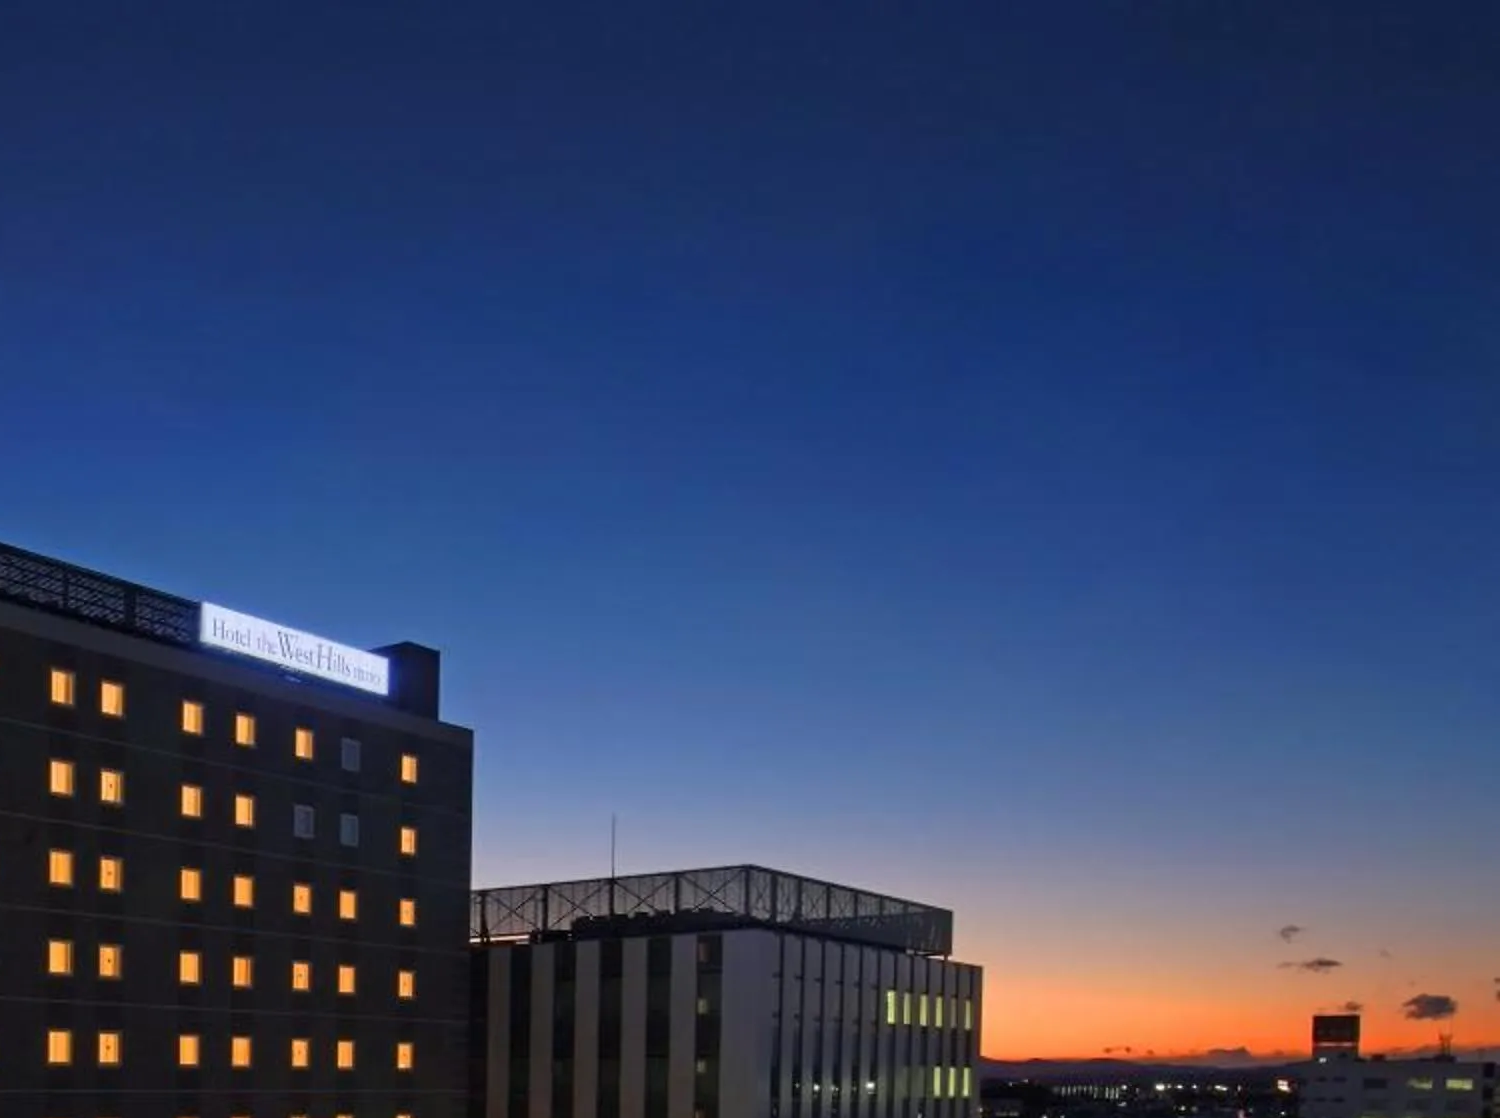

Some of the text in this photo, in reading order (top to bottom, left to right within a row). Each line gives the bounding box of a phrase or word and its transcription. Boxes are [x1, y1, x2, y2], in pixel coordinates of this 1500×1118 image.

[212, 617, 252, 648] Hotel
[257, 633, 276, 656] the
[277, 630, 314, 665] West
[316, 642, 351, 678] Hills
